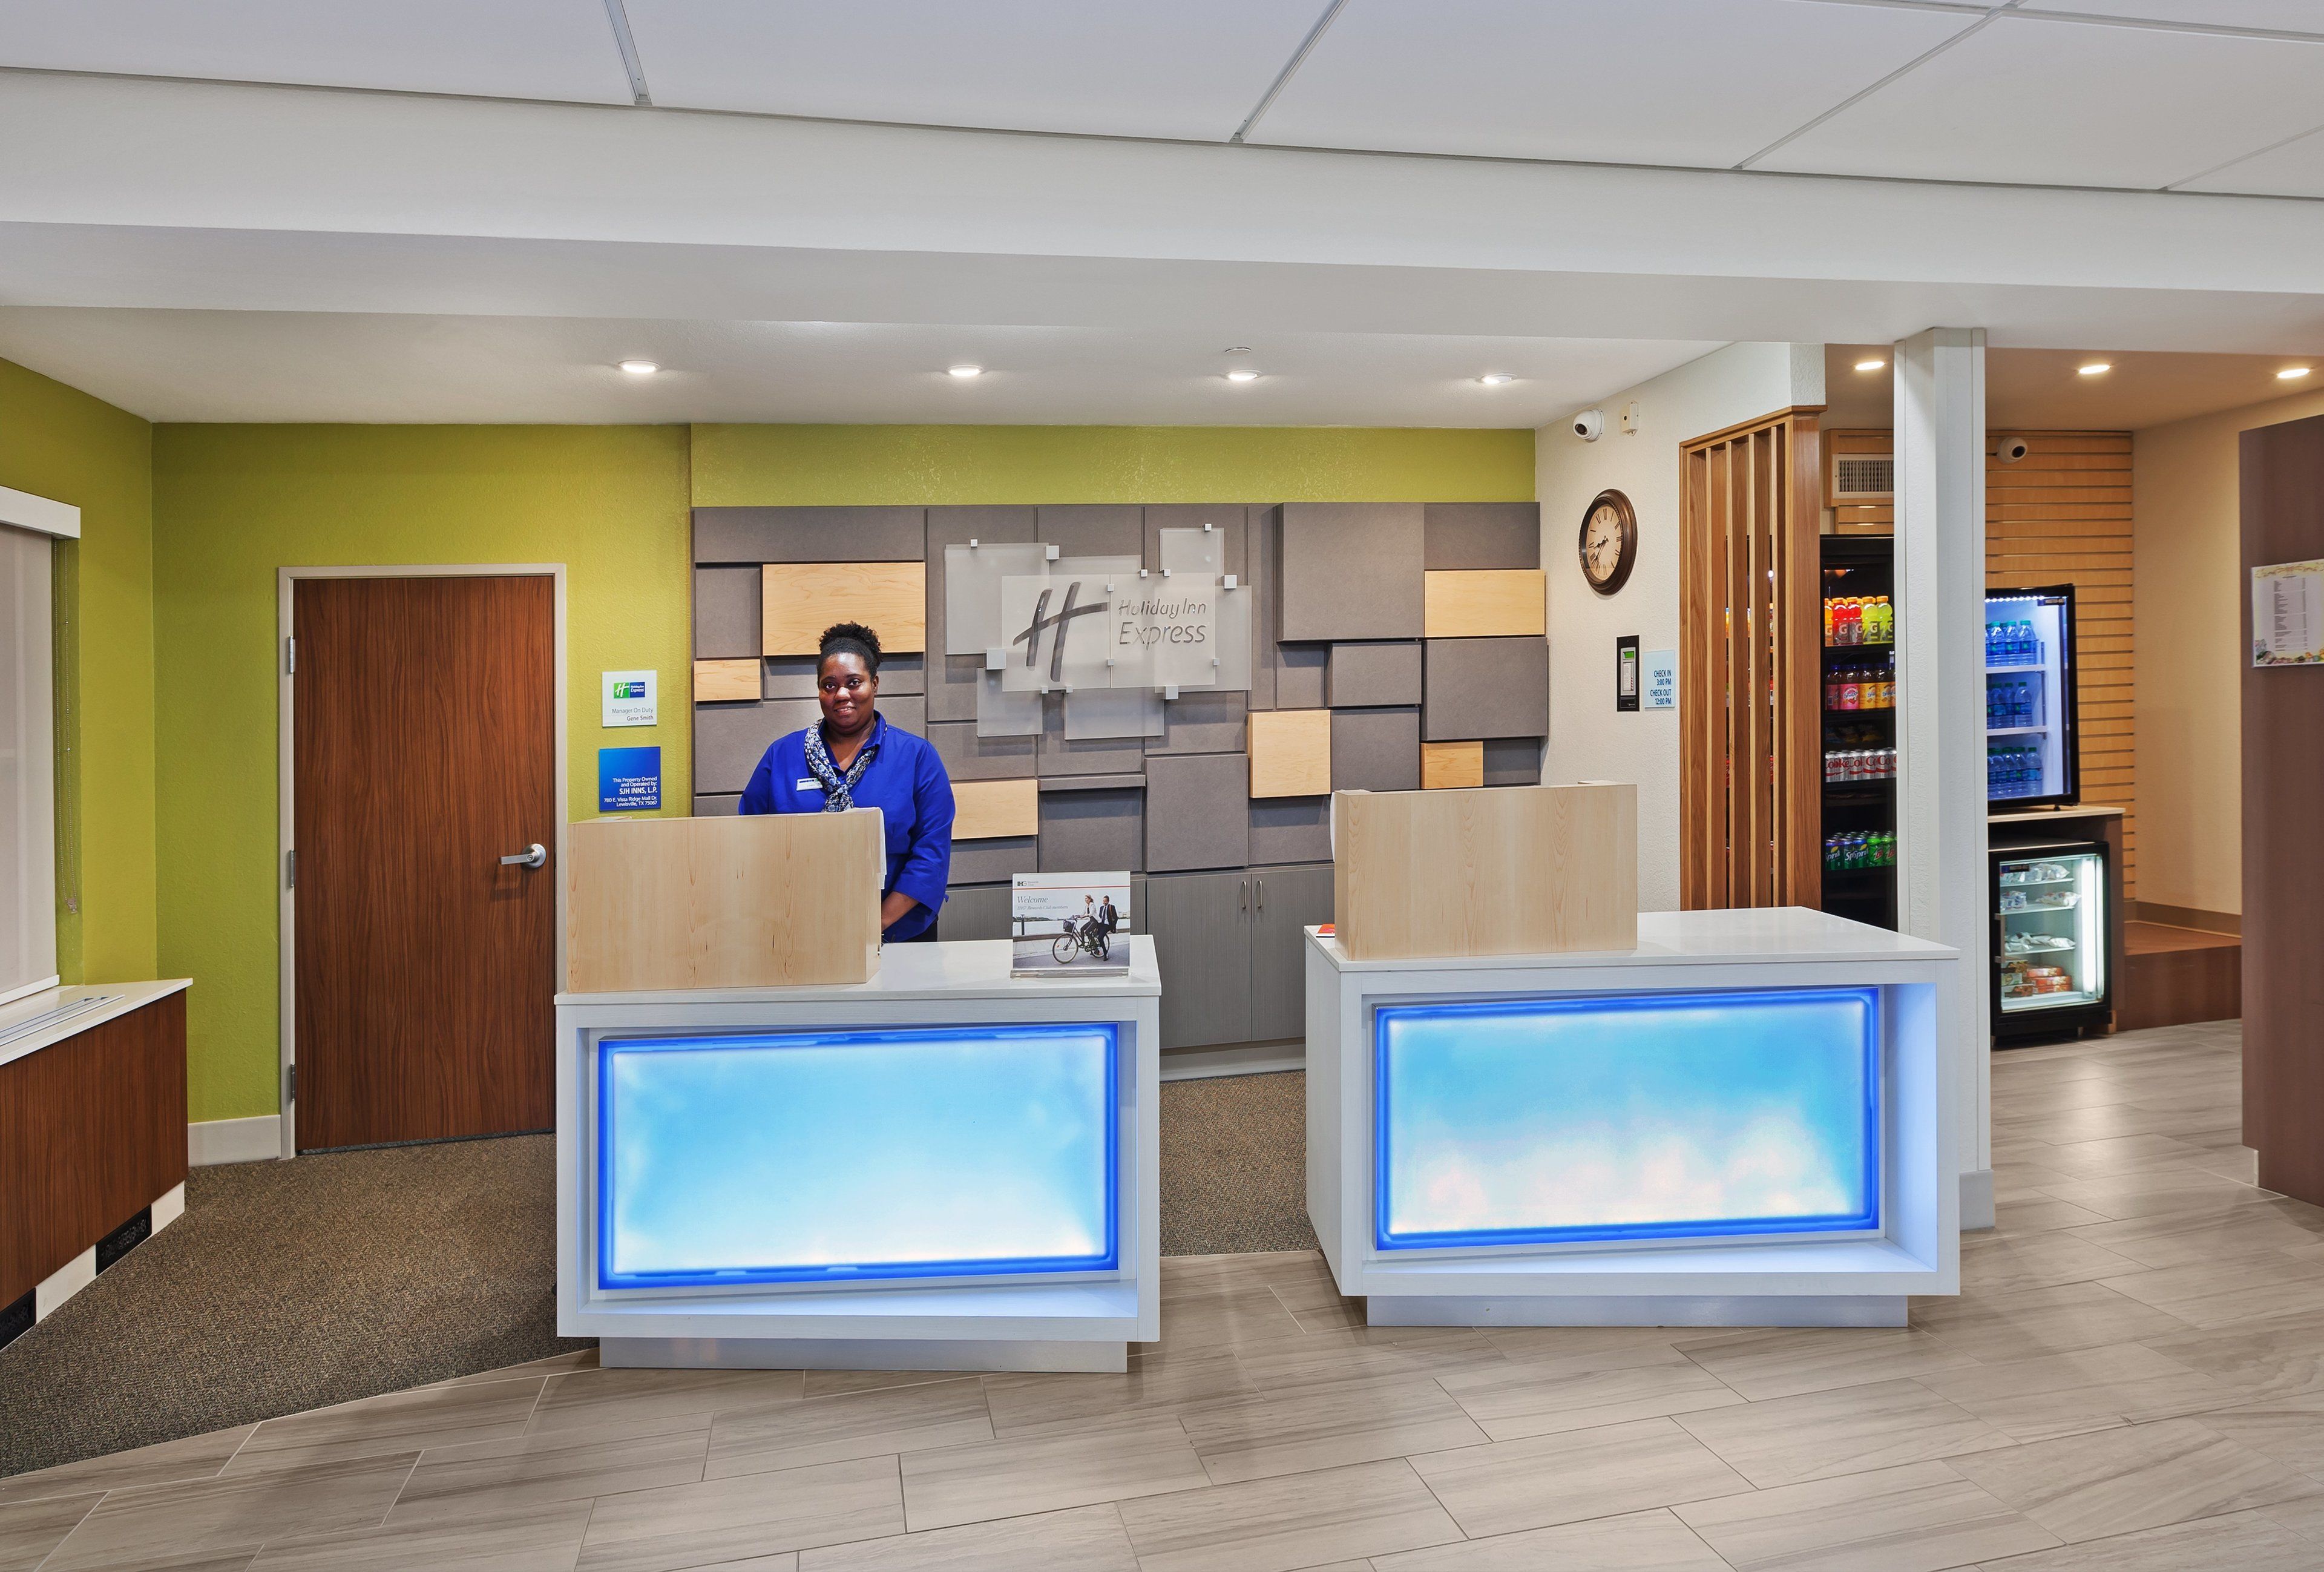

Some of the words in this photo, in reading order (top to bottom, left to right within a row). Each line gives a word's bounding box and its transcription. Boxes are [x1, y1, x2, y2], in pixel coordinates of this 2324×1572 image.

[1118, 599, 1180, 619] Holiday
[1182, 597, 1207, 614] Inn
[1118, 622, 1207, 650] Express
